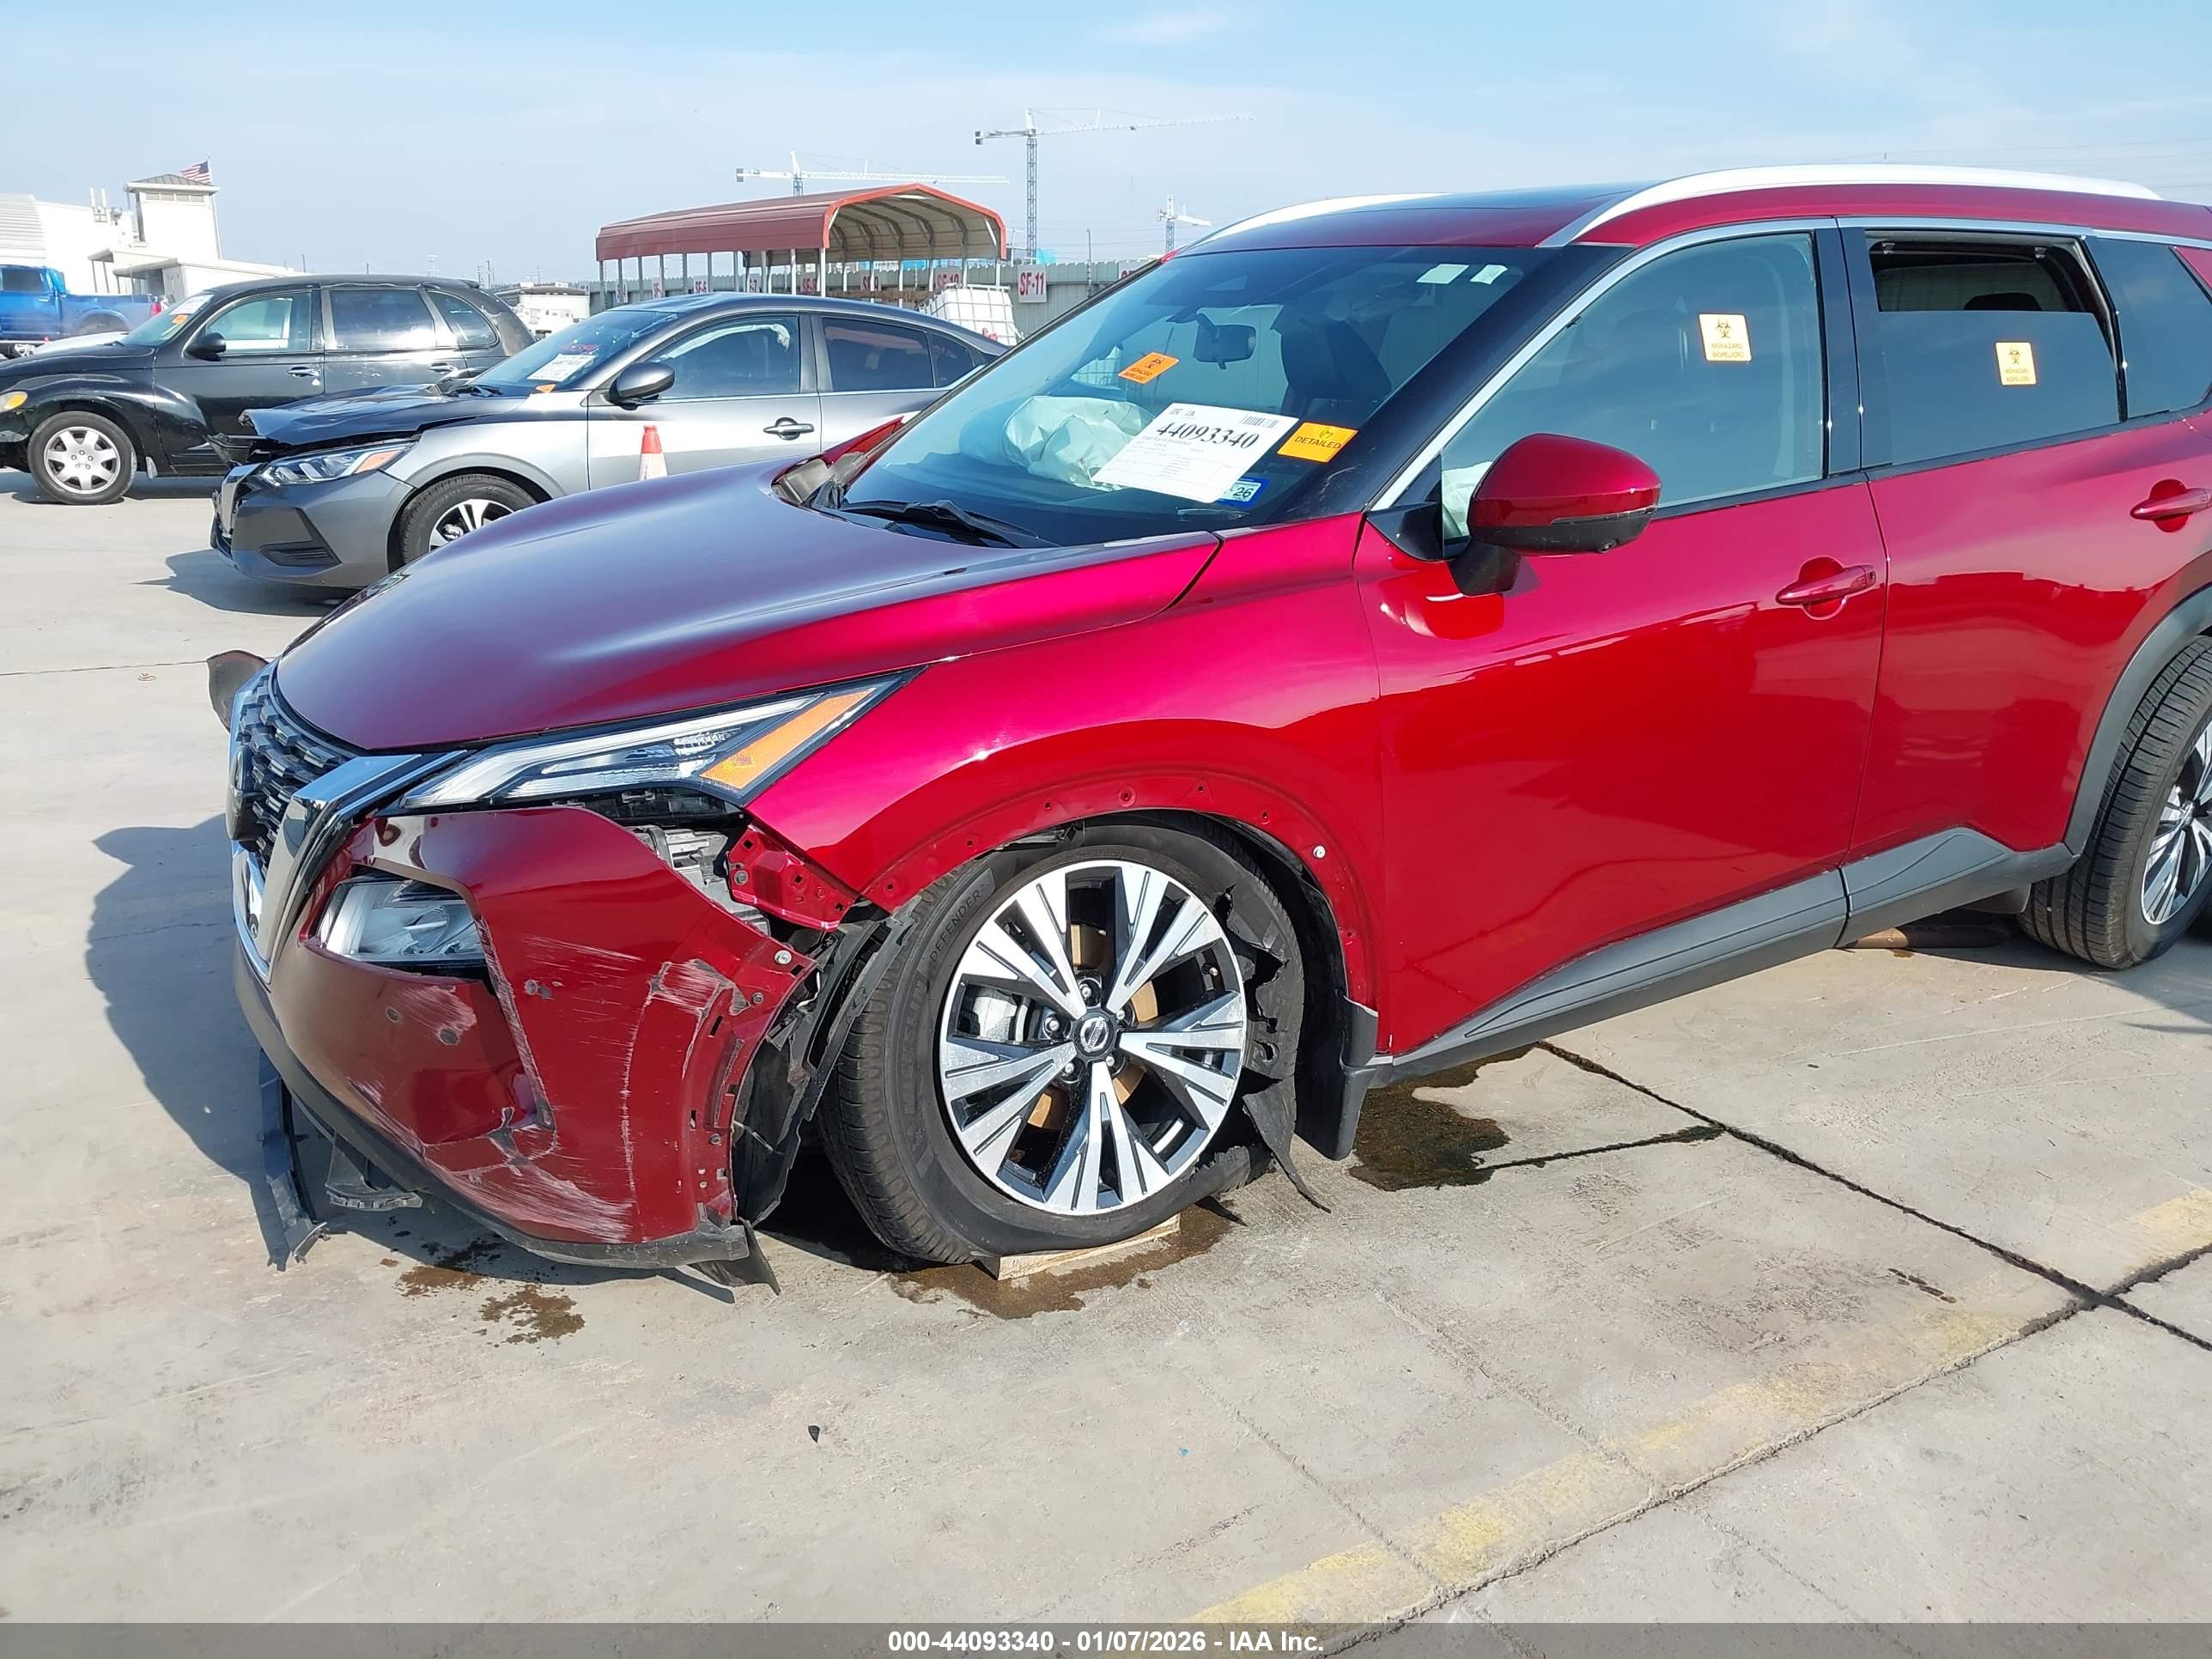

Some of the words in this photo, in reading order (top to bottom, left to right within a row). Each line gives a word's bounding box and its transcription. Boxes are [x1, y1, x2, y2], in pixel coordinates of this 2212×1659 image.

[863, 276, 880, 292] SF9
[1019, 272, 1045, 296] SF-11
[1157, 422, 1261, 449] 44093340
[1294, 436, 1341, 449] DETAILED
[1232, 487, 1255, 498] 26
[929, 890, 981, 963] DEFENDER
